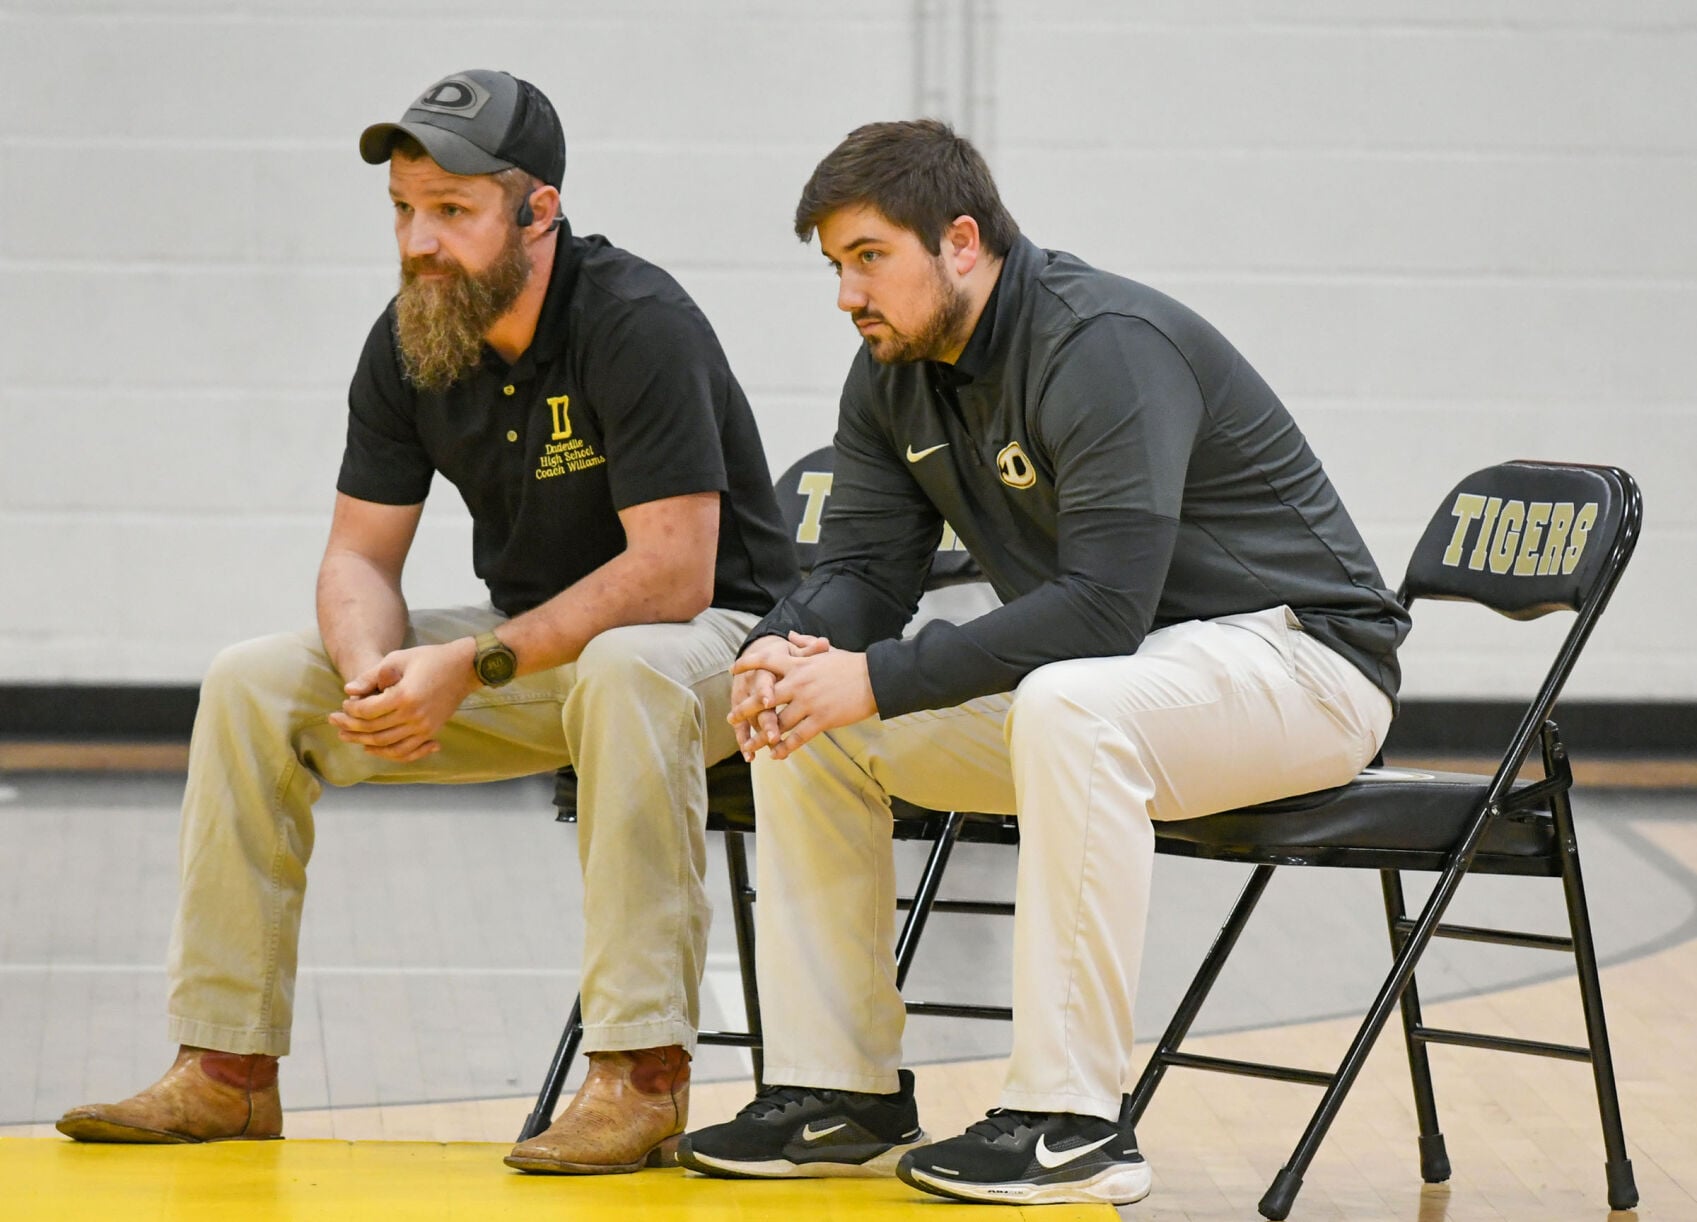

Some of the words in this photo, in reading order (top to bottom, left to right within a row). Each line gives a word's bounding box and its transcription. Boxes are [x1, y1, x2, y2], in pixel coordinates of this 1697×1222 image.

[423, 82, 473, 108] D
[546, 395, 572, 440] D
[540, 454, 563, 468] High
[564, 445, 594, 462] School
[535, 465, 566, 480] Coach
[1442, 493, 1598, 576] TIGERS
